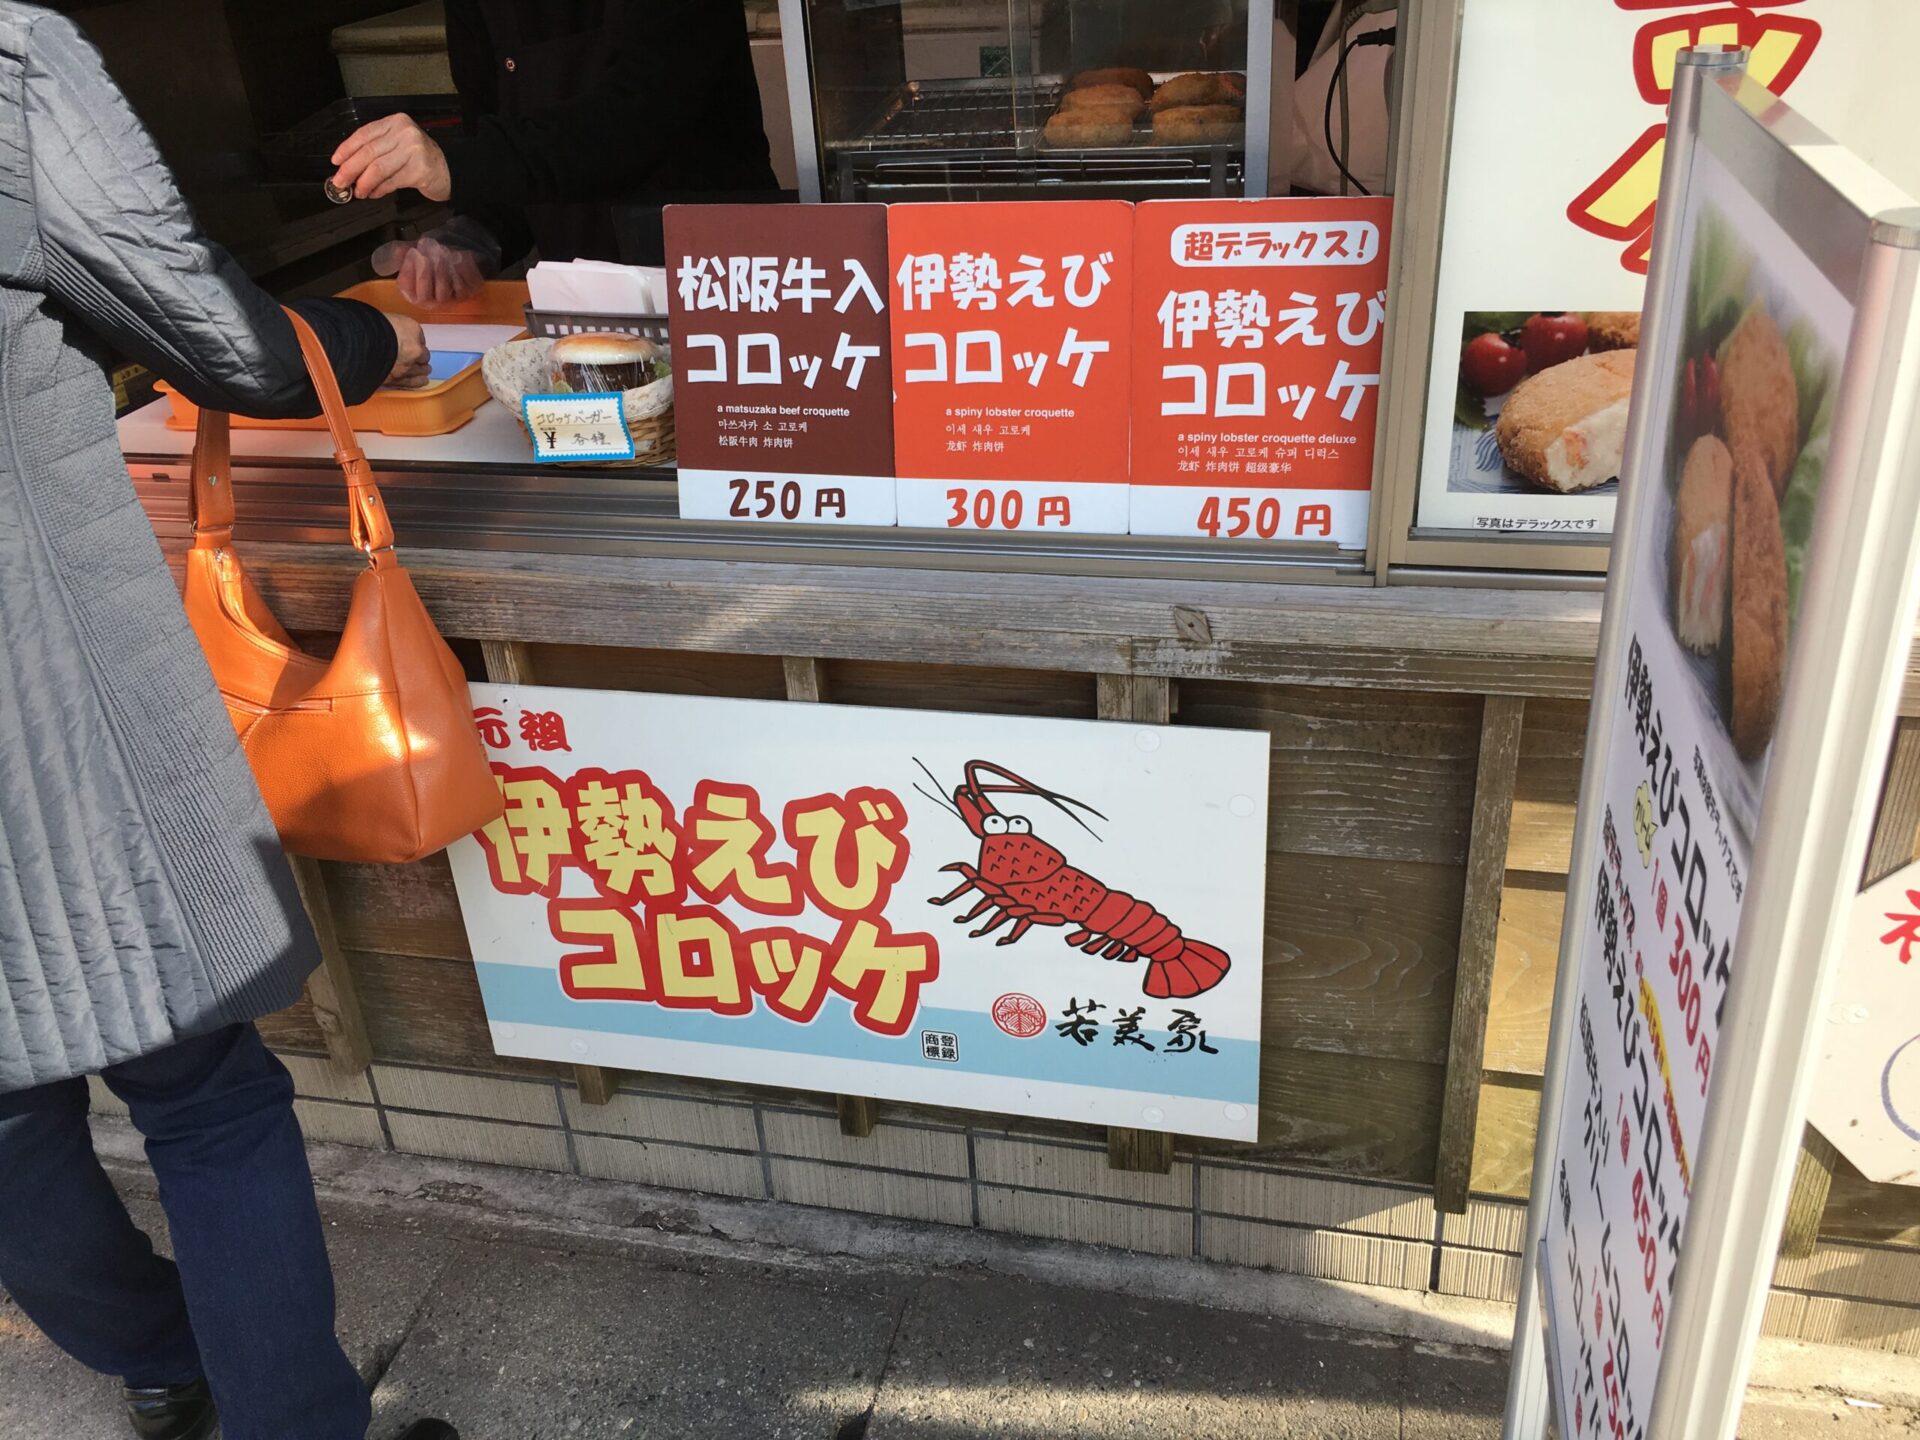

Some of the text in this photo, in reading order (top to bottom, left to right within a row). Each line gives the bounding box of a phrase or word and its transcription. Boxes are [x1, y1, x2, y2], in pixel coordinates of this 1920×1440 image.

[1184, 229, 1368, 261] 超デラックス！
[677, 255, 885, 314] 松阪牛入
[896, 251, 1114, 311] 伊勢えび
[1157, 289, 1387, 349] 伊勢えび
[686, 332, 881, 391] コロッケ
[905, 327, 1110, 388] コロッケ
[536, 409, 612, 425] コロッケバーガー
[726, 404, 777, 414] matsuzaka
[779, 405, 800, 415] beef
[803, 407, 850, 418] croquette
[945, 407, 1075, 419] a spiny lobster croquette
[1161, 359, 1380, 421] コロッケ
[763, 421, 773, 431] 소
[778, 421, 808, 432] 고로케
[1187, 433, 1217, 444] spiny
[1220, 432, 1259, 442] lobster
[1261, 434, 1315, 445] croquette
[1318, 434, 1357, 444] deluxe
[1476, 517, 1598, 529] 写真はデラックスです
[473, 707, 573, 752] 元祖
[476, 765, 908, 916] 伊勢えび
[1624, 631, 1733, 1031] 伊勢えびコロッケ
[550, 905, 938, 1032] コロッケ
